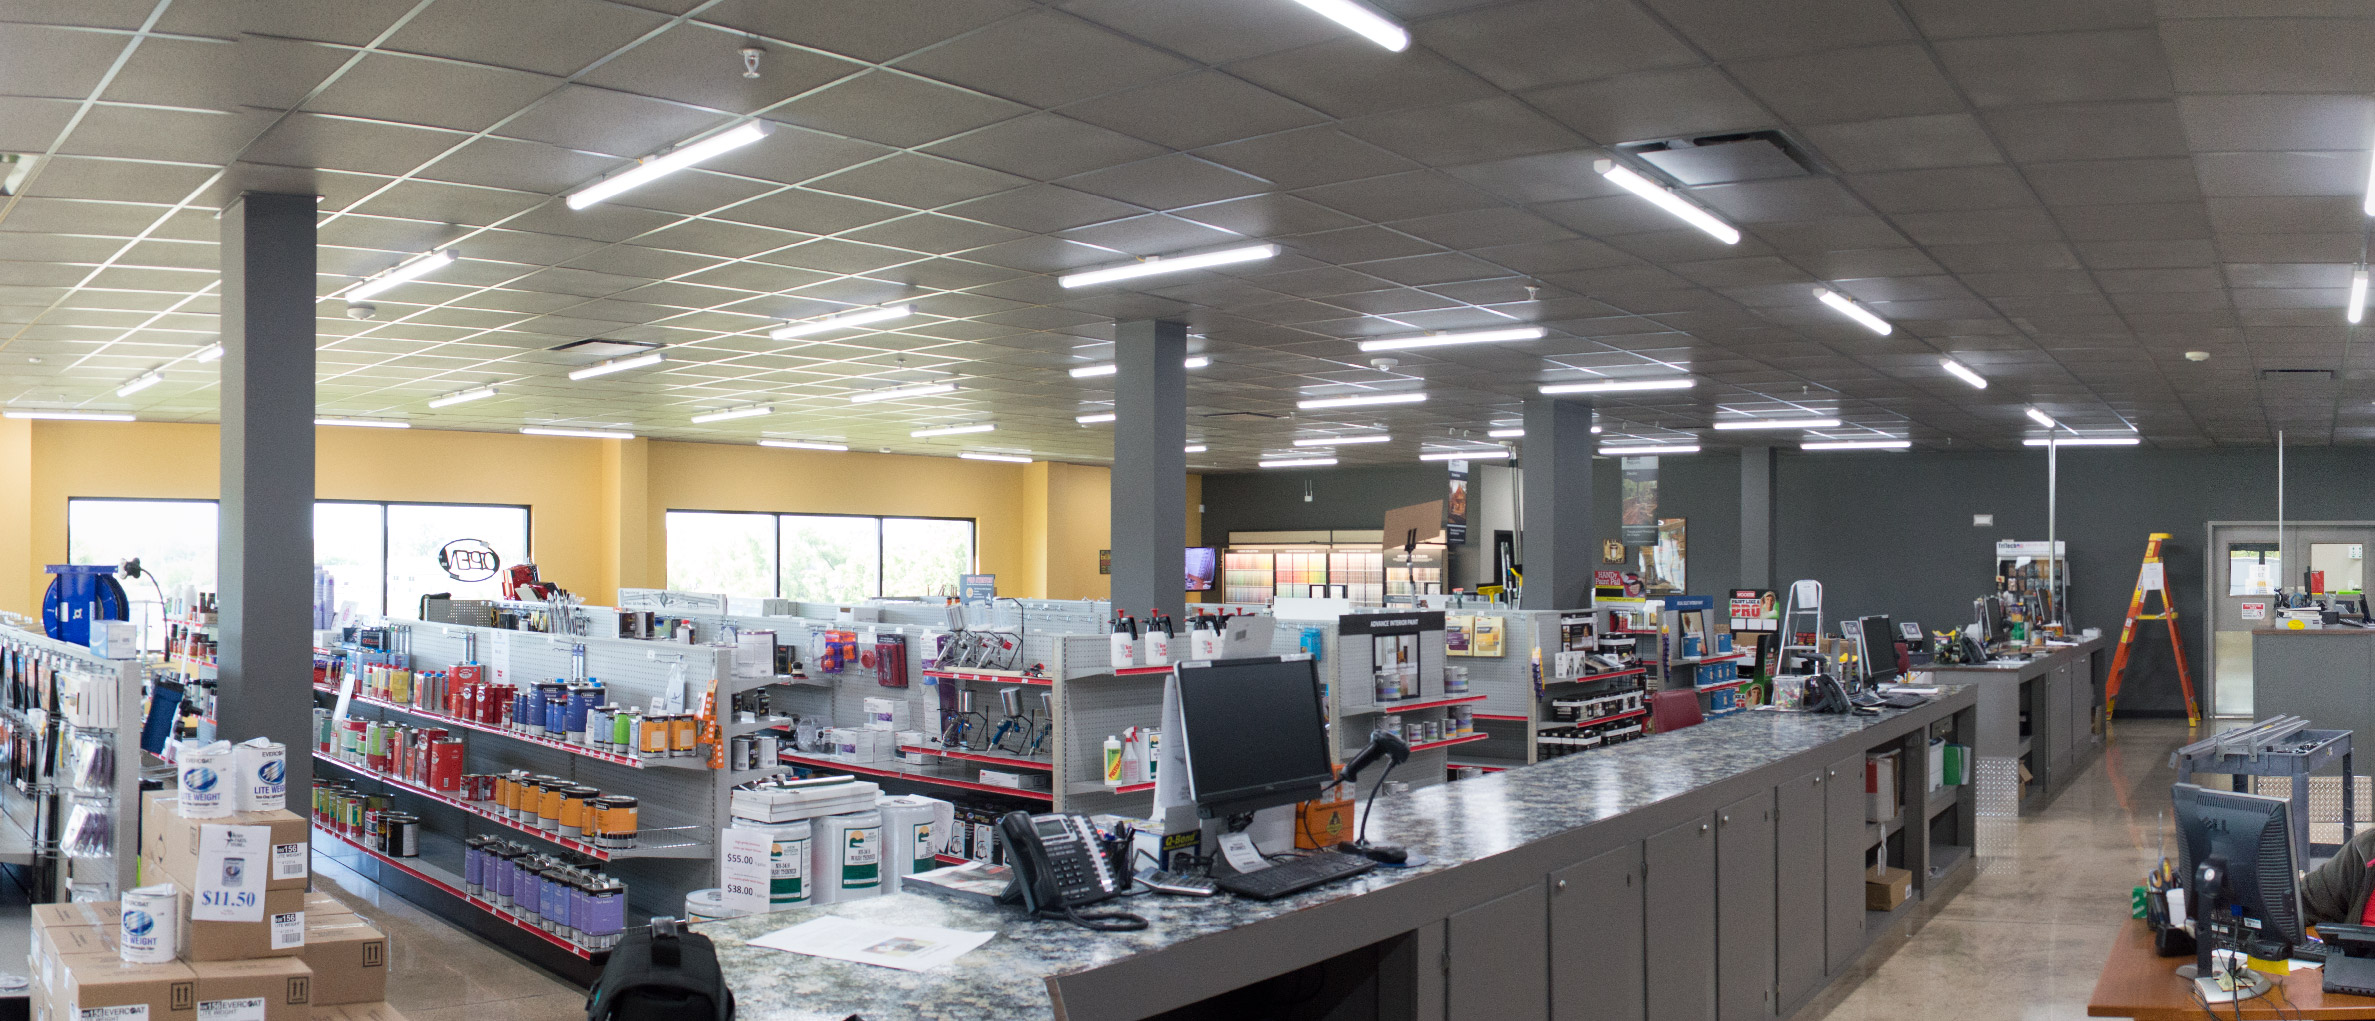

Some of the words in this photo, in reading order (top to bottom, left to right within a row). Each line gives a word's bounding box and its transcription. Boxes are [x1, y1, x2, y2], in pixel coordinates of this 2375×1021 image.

[1731, 604, 1760, 617] PRO
[254, 786, 269, 794] LITE
[193, 792, 221, 801] WEIGHT
[727, 853, 753, 865] $55.00
[727, 884, 753, 896] $38.00
[202, 889, 256, 907] $11.50
[129, 936, 158, 946] WEIGHT
[222, 1000, 262, 1009] EVERCOAT
[104, 1006, 145, 1016] EVERCOAT
